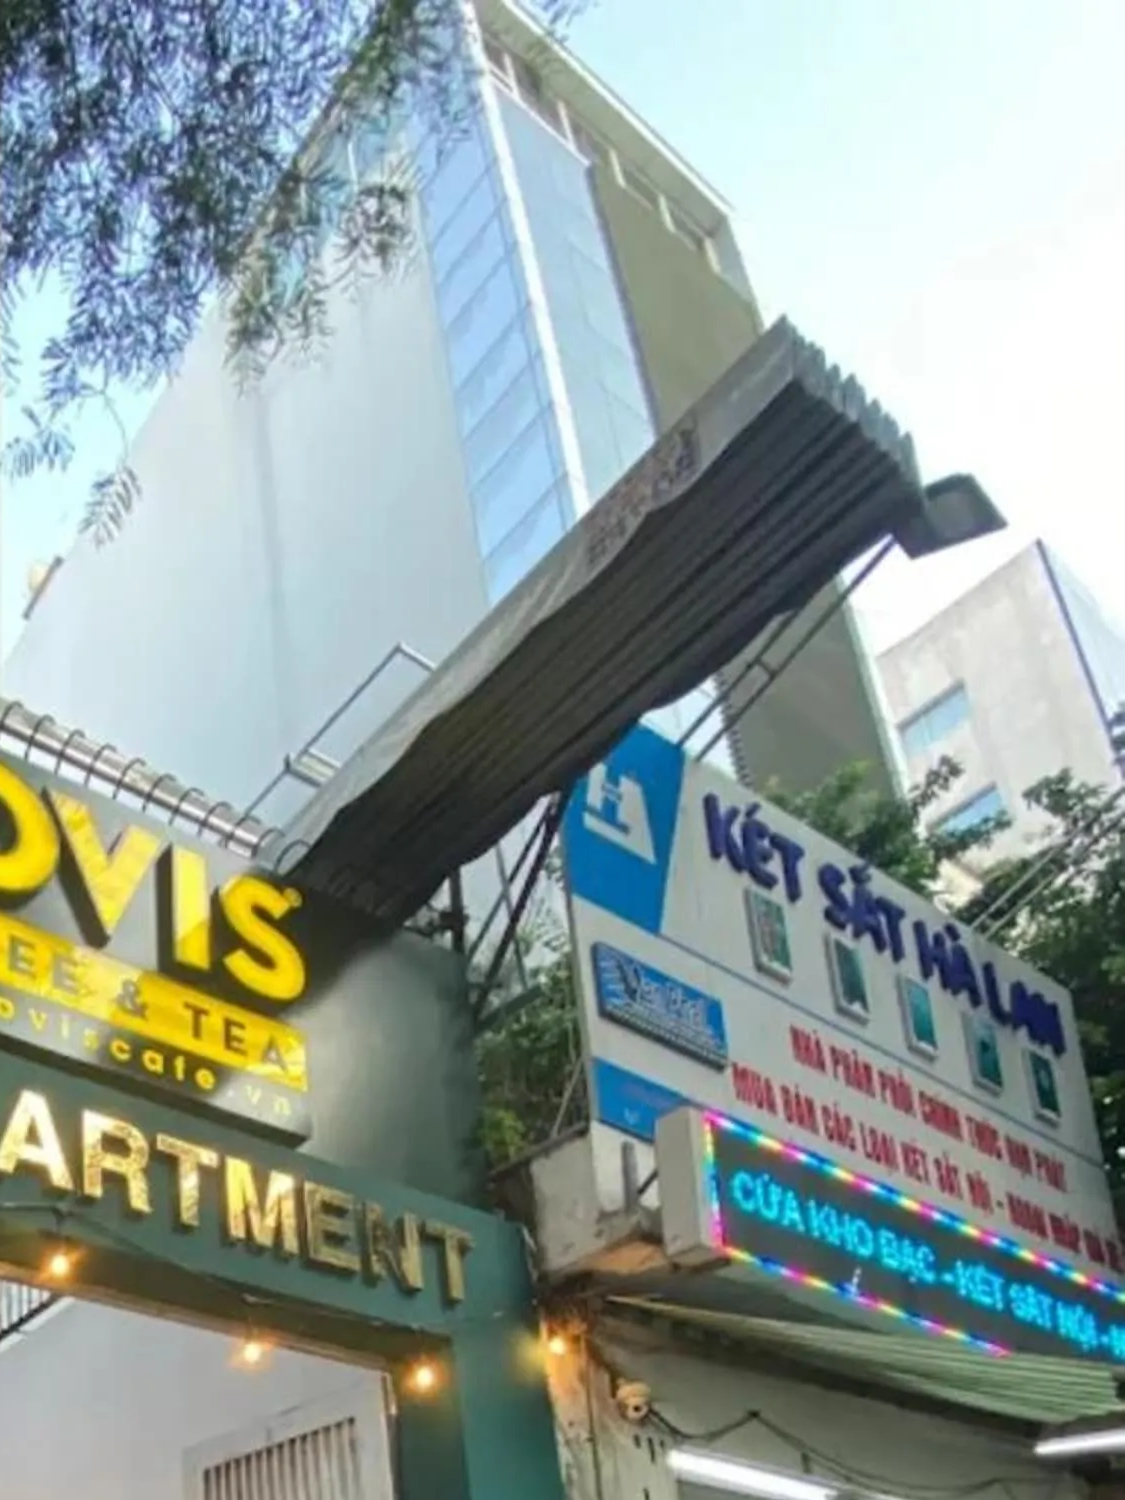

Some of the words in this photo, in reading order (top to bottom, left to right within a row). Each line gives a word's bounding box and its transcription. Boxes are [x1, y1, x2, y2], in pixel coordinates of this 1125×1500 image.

[704, 793, 805, 903] KÉT
[118, 979, 149, 1021] &
[183, 1001, 291, 1074] TEA
[808, 1199, 875, 1259] KHO
